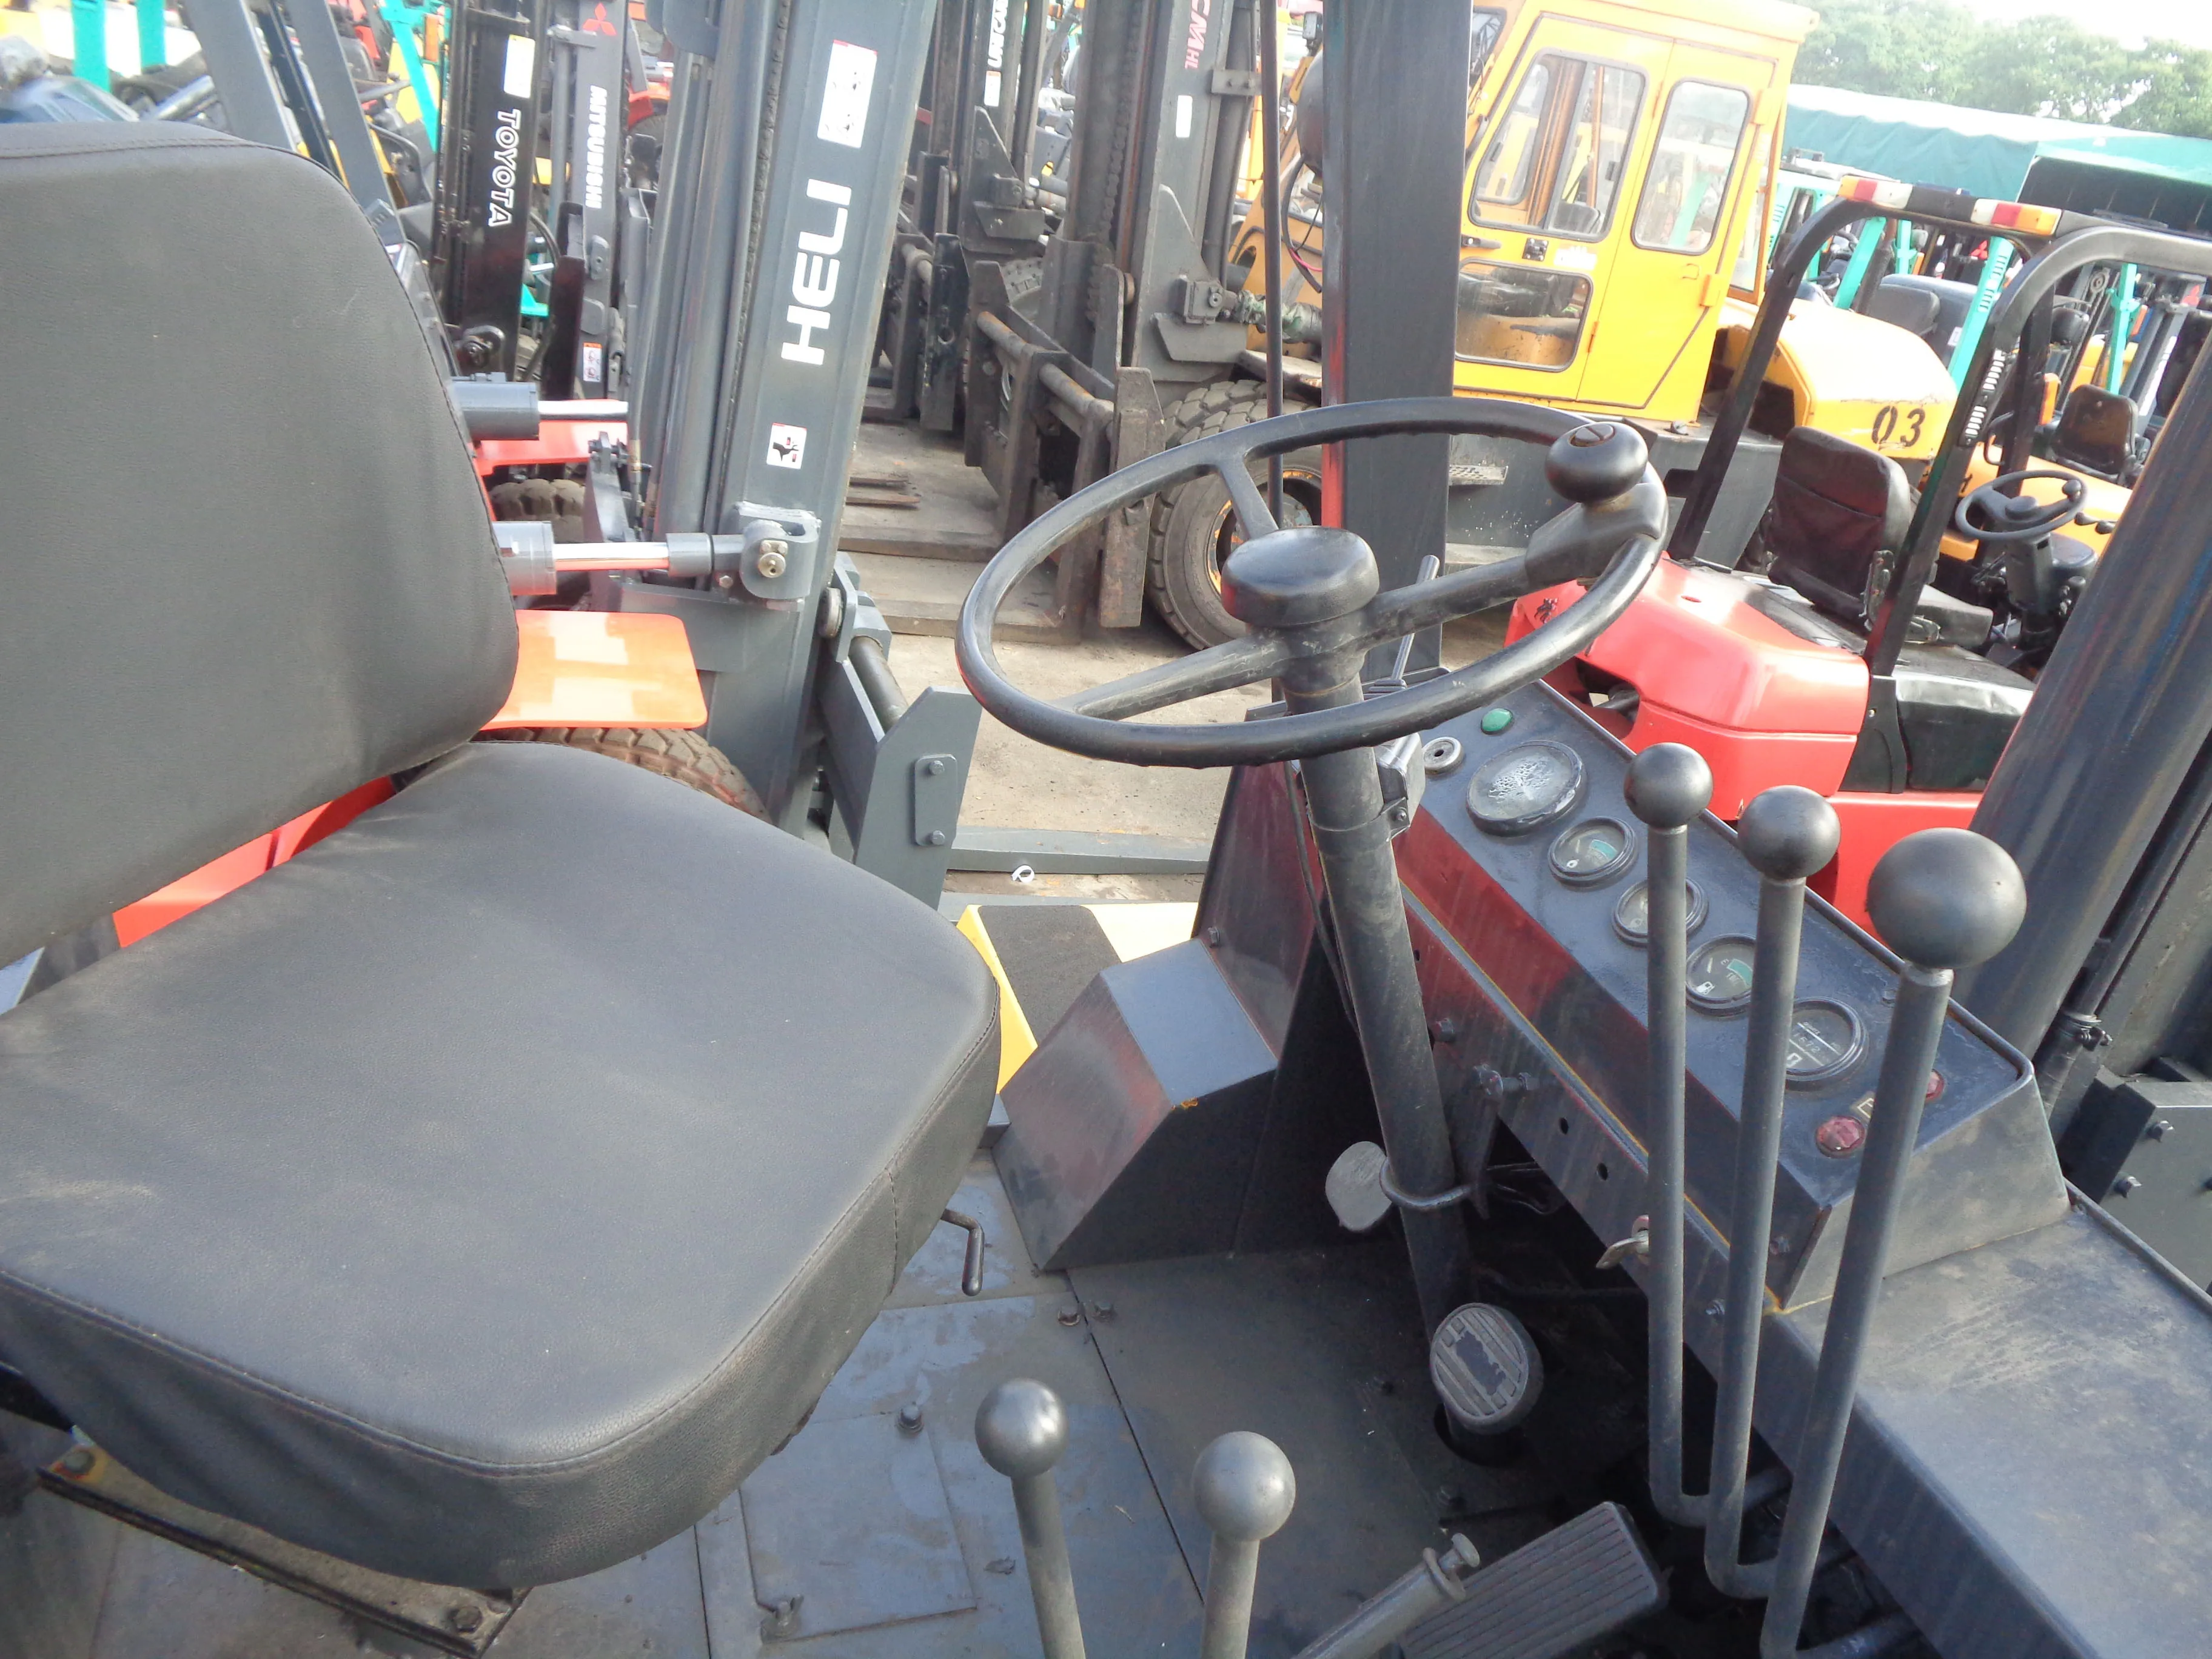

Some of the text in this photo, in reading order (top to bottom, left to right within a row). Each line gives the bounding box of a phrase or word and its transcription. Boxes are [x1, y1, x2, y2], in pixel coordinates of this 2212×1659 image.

[488, 109, 521, 227] TOYOTA
[585, 85, 607, 209] MITSUBISHI
[781, 178, 851, 365] HELI
[1871, 405, 1926, 447] 03
